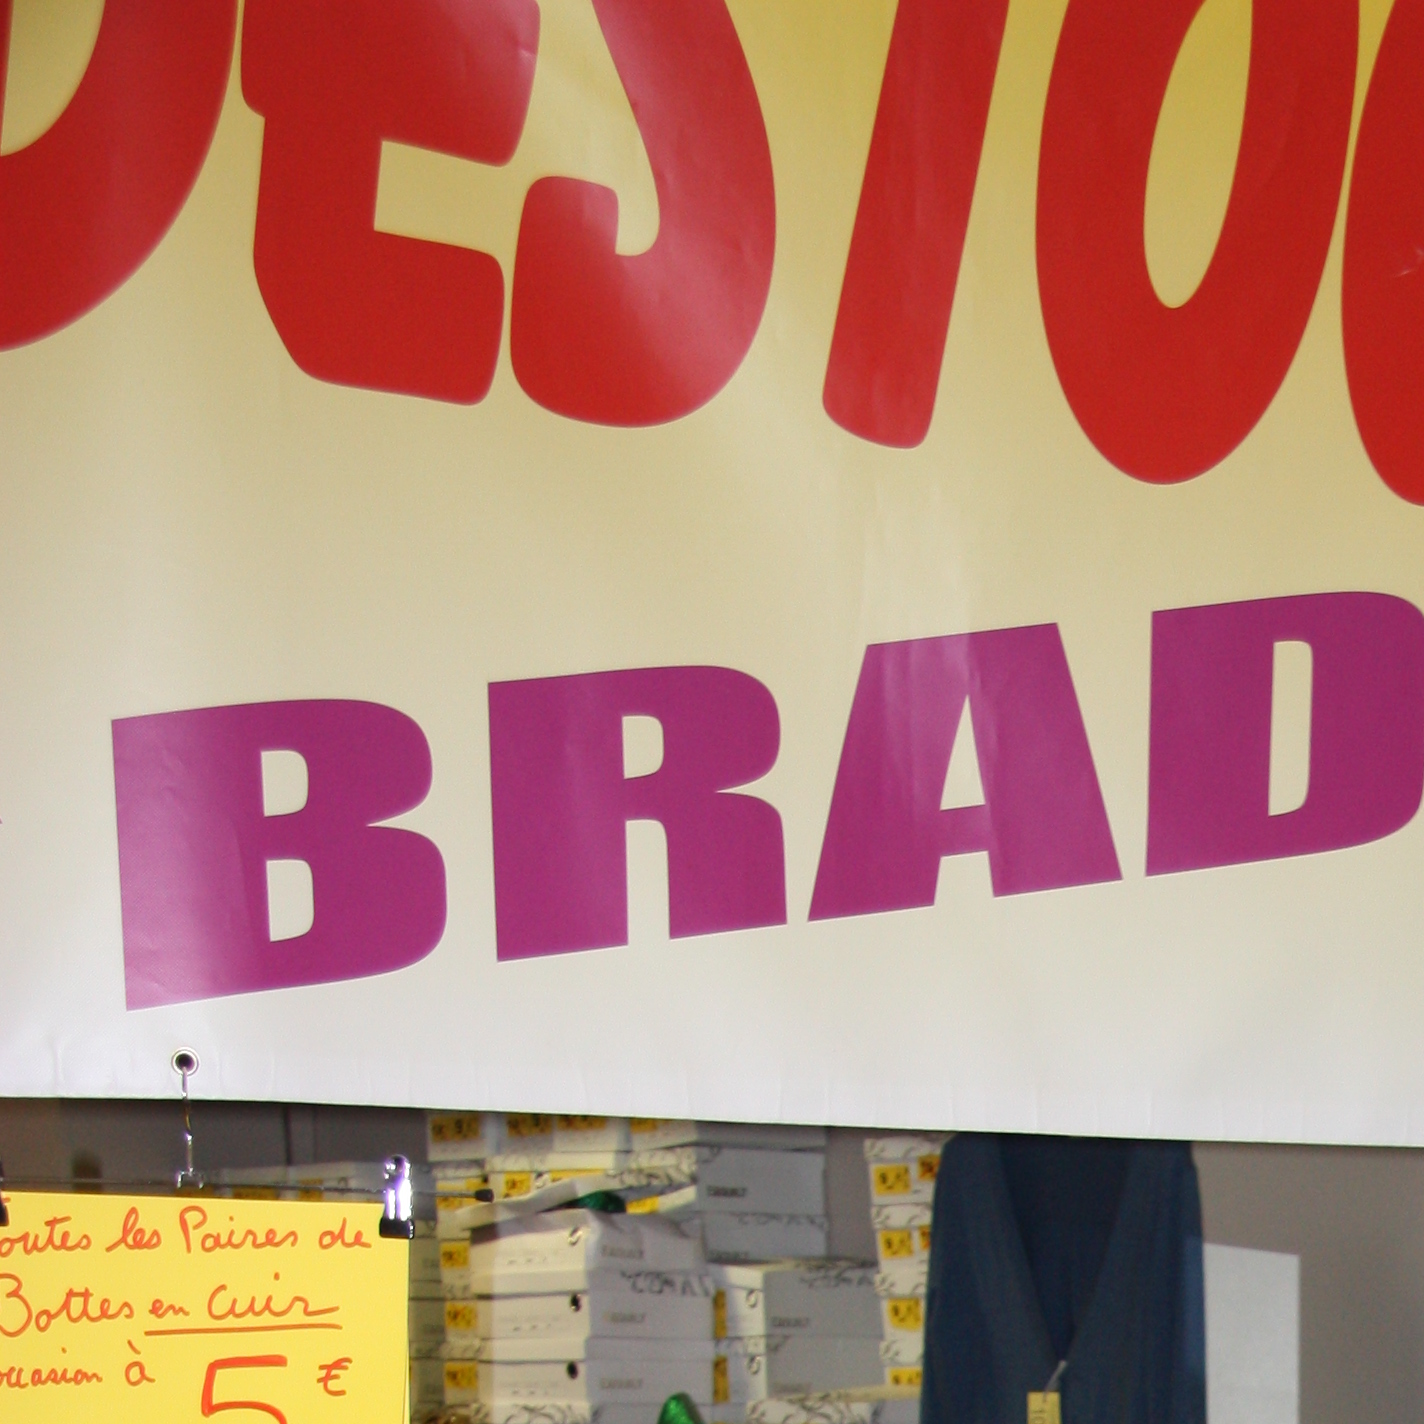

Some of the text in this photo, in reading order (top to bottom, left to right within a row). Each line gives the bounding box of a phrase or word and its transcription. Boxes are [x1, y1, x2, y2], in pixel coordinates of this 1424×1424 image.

[0, 1203, 372, 1258] outes les Paires de
[148, 1298, 191, 1319] en
[207, 1272, 340, 1321] Cuir
[0, 1346, 103, 1389] ccasion
[124, 1339, 156, 1387] à
[317, 1356, 354, 1397] €
